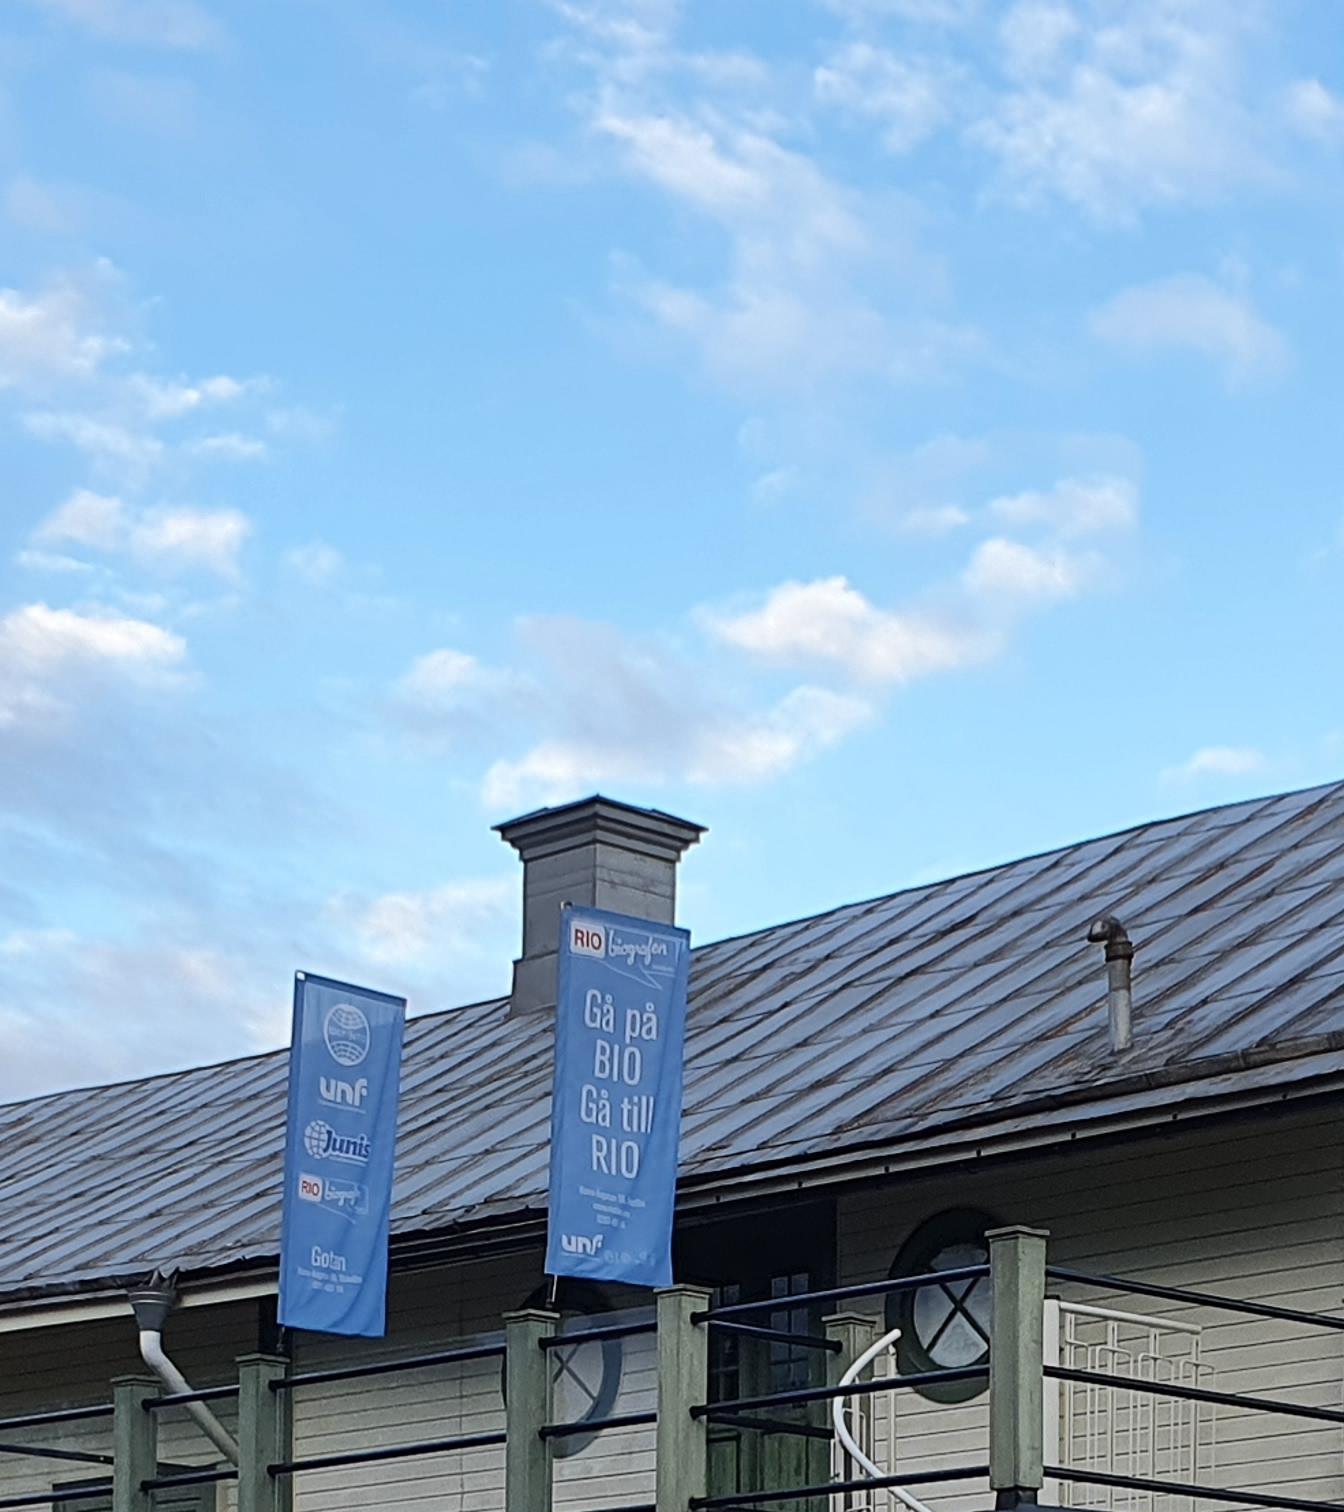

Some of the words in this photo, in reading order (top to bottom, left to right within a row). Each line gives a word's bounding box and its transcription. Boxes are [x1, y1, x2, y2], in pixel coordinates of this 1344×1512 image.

[574, 928, 602, 950] RIO
[608, 929, 668, 966] biografen
[584, 988, 614, 1034] Gå
[625, 1002, 658, 1044] på
[594, 1039, 641, 1085] BIO
[320, 1076, 368, 1106] unf
[580, 1084, 611, 1128] Gå
[620, 1095, 654, 1134] till
[323, 1129, 371, 1160] Junis
[592, 1134, 640, 1179] RIO
